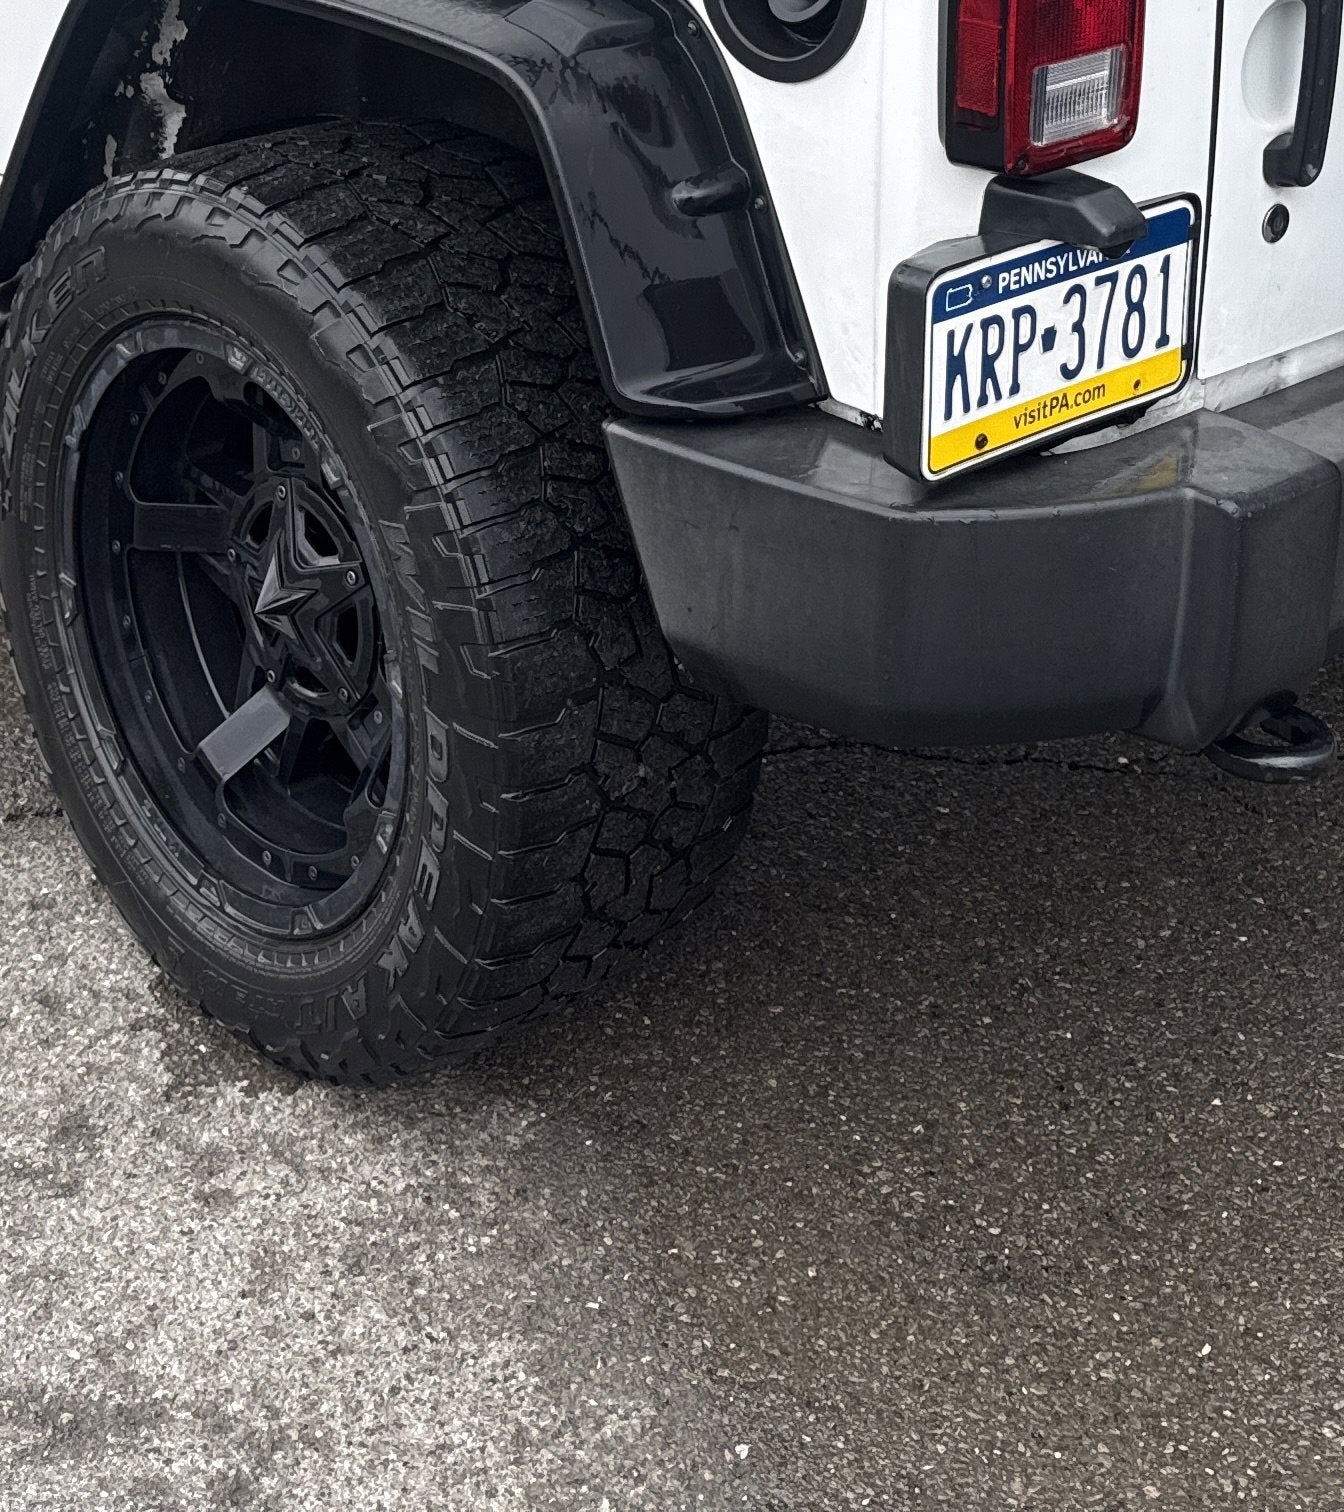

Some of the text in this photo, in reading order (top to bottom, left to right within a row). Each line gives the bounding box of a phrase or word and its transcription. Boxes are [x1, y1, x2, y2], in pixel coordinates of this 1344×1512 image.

[998, 249, 1105, 294] PENNSYLVA
[1012, 381, 1107, 429] visitPA.com
[377, 519, 449, 995] WILDPEAK
